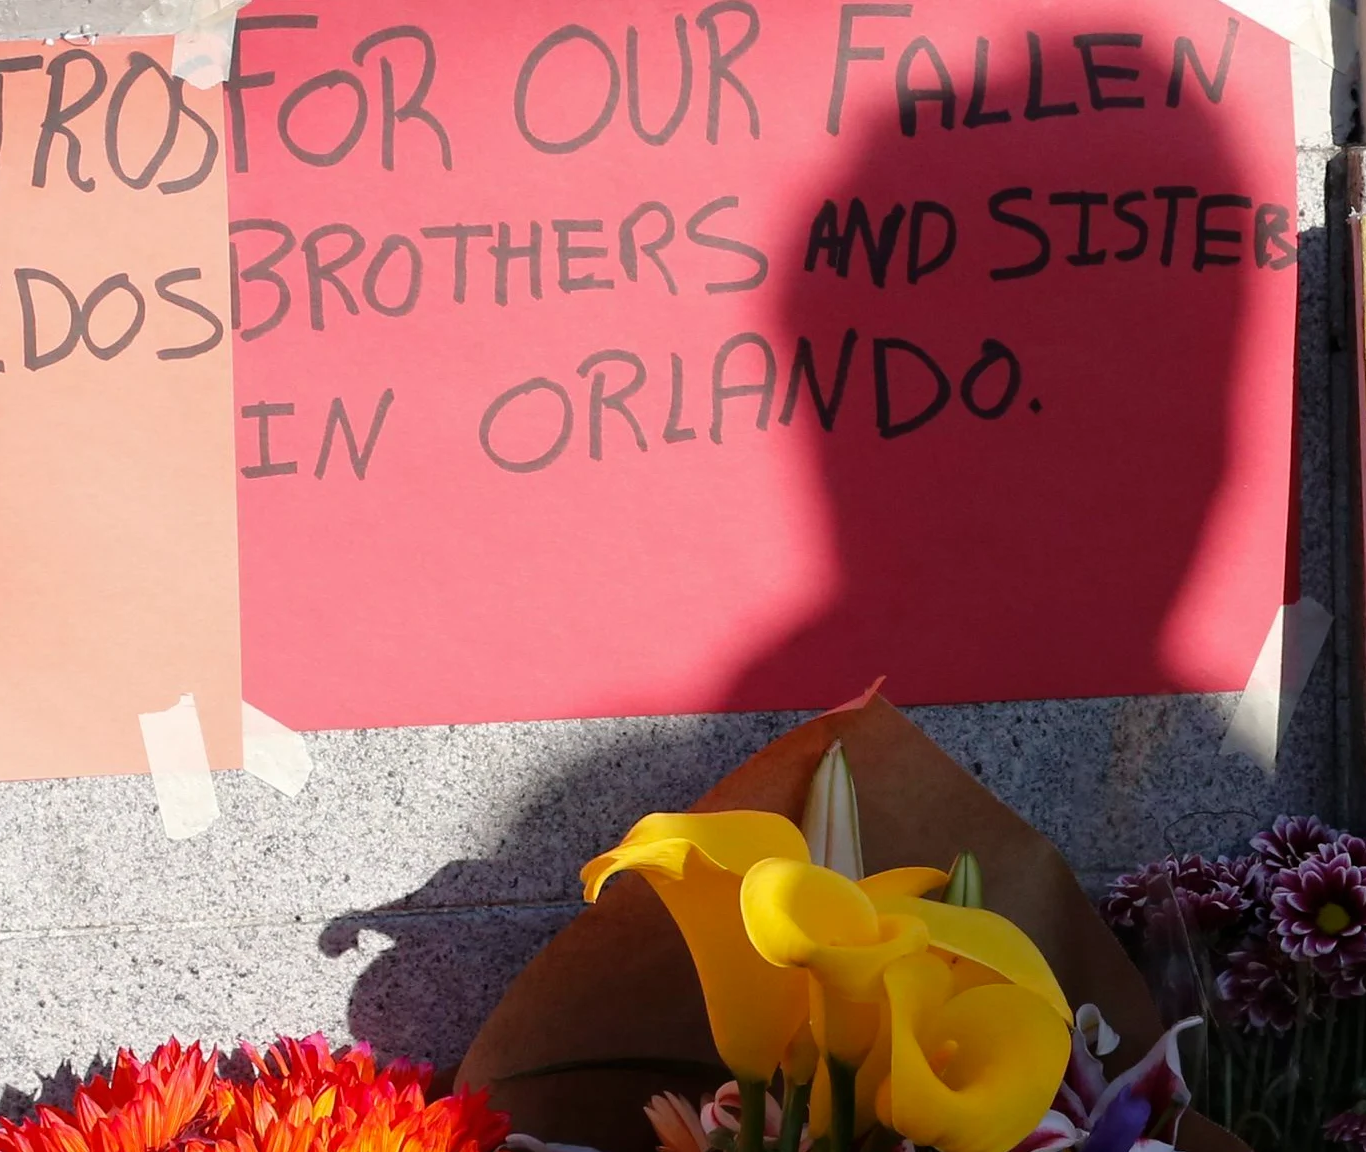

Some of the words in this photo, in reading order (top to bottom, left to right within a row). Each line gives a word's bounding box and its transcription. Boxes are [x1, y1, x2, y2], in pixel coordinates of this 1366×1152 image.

[223, 14, 453, 172] FOR
[513, 0, 761, 155] OUR
[825, 3, 1240, 138] FALLEN
[229, 195, 769, 341] BROTHERS
[803, 198, 957, 287] AND
[239, 388, 394, 481] IN
[478, 328, 1044, 474] ORLANDO.
